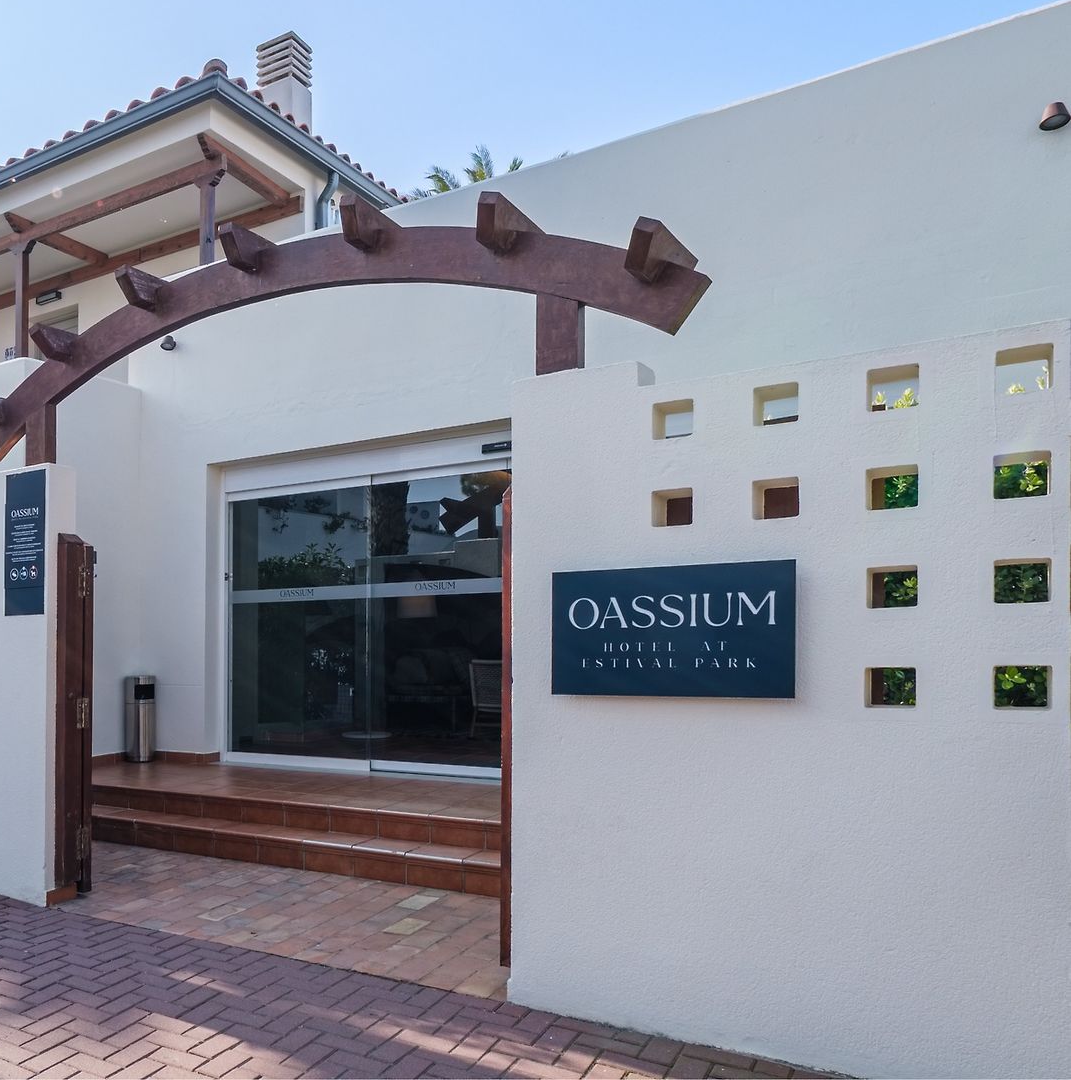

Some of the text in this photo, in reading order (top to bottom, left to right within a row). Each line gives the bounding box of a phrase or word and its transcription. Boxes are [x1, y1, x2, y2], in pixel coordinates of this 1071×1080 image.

[10, 507, 38, 518] OASSIUM
[414, 581, 456, 591] OASSIUM
[279, 588, 314, 598] OASSIUM
[568, 590, 777, 630] OASSIUM
[603, 640, 729, 652] HOTEL AT
[581, 657, 757, 669] ESTIVAL PARK
